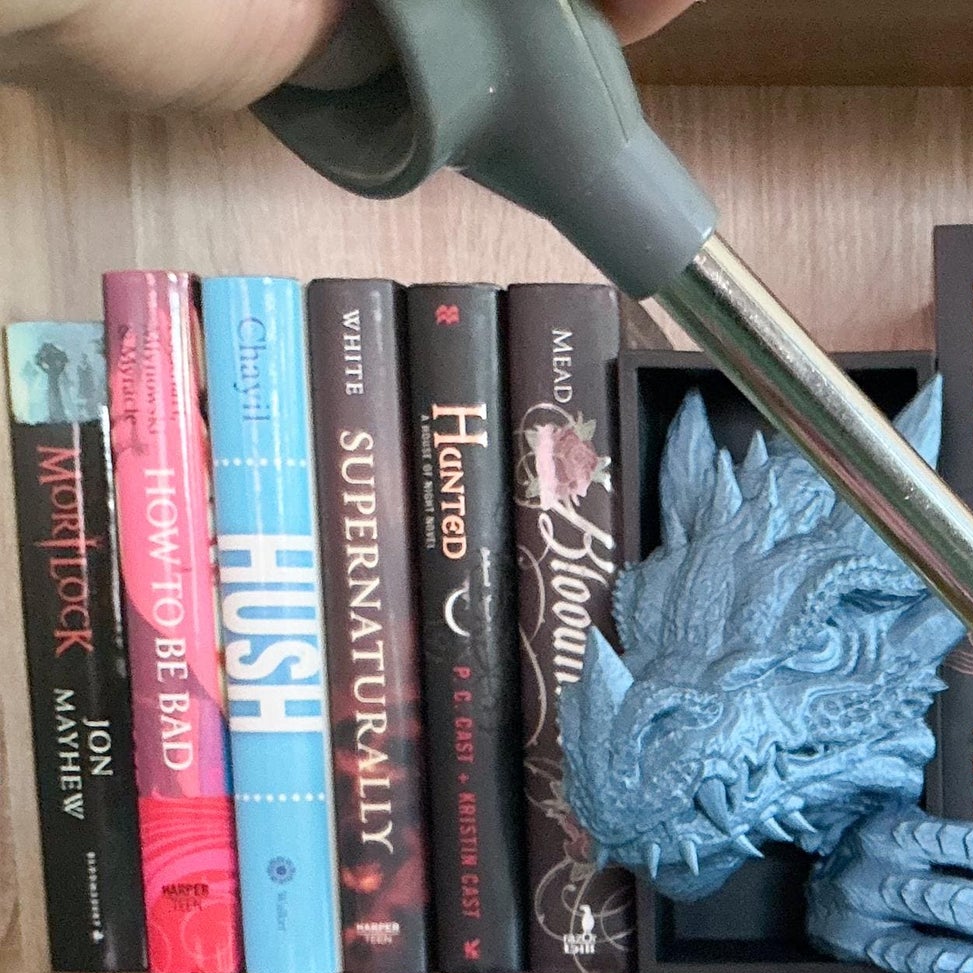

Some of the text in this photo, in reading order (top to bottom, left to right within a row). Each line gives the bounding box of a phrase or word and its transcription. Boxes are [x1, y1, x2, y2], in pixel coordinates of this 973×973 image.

[235, 317, 270, 422] Chayil
[341, 309, 364, 396] WHITE
[551, 328, 574, 403] MEAD
[36, 446, 100, 657] MORTLOCK
[144, 468, 193, 771] HOW TO BE BAD
[216, 534, 323, 733] HUSH
[339, 429, 394, 854] SUPERNATURALLY
[53, 688, 84, 820] MAYHEW
[84, 719, 113, 776] JON
[455, 717, 475, 763] CAST
[458, 792, 478, 866] KRISTIN
[461, 874, 480, 918] CAST
